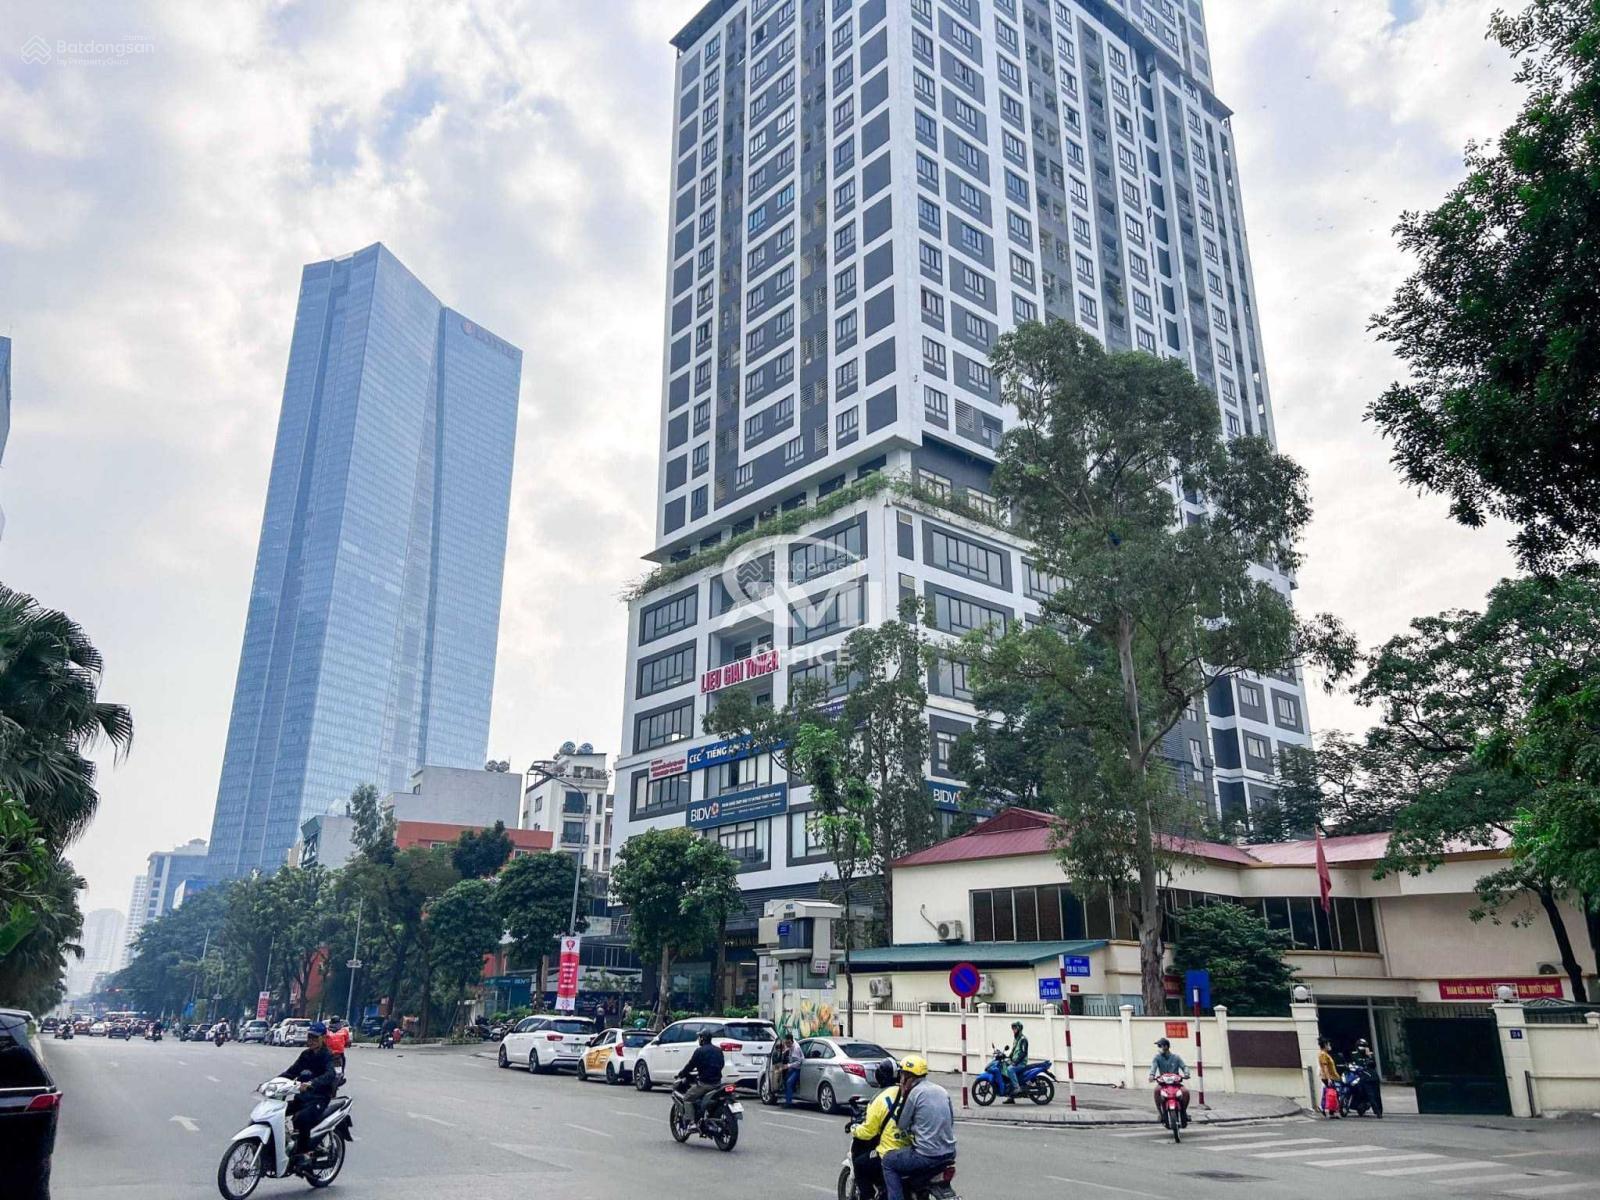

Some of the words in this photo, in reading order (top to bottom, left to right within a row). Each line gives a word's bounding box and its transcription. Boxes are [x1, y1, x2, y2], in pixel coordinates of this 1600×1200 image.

[723, 661, 744, 686] GIAI
[745, 650, 779, 679] TOWER
[933, 788, 957, 804] BIDV
[690, 805, 712, 822] BIDV
